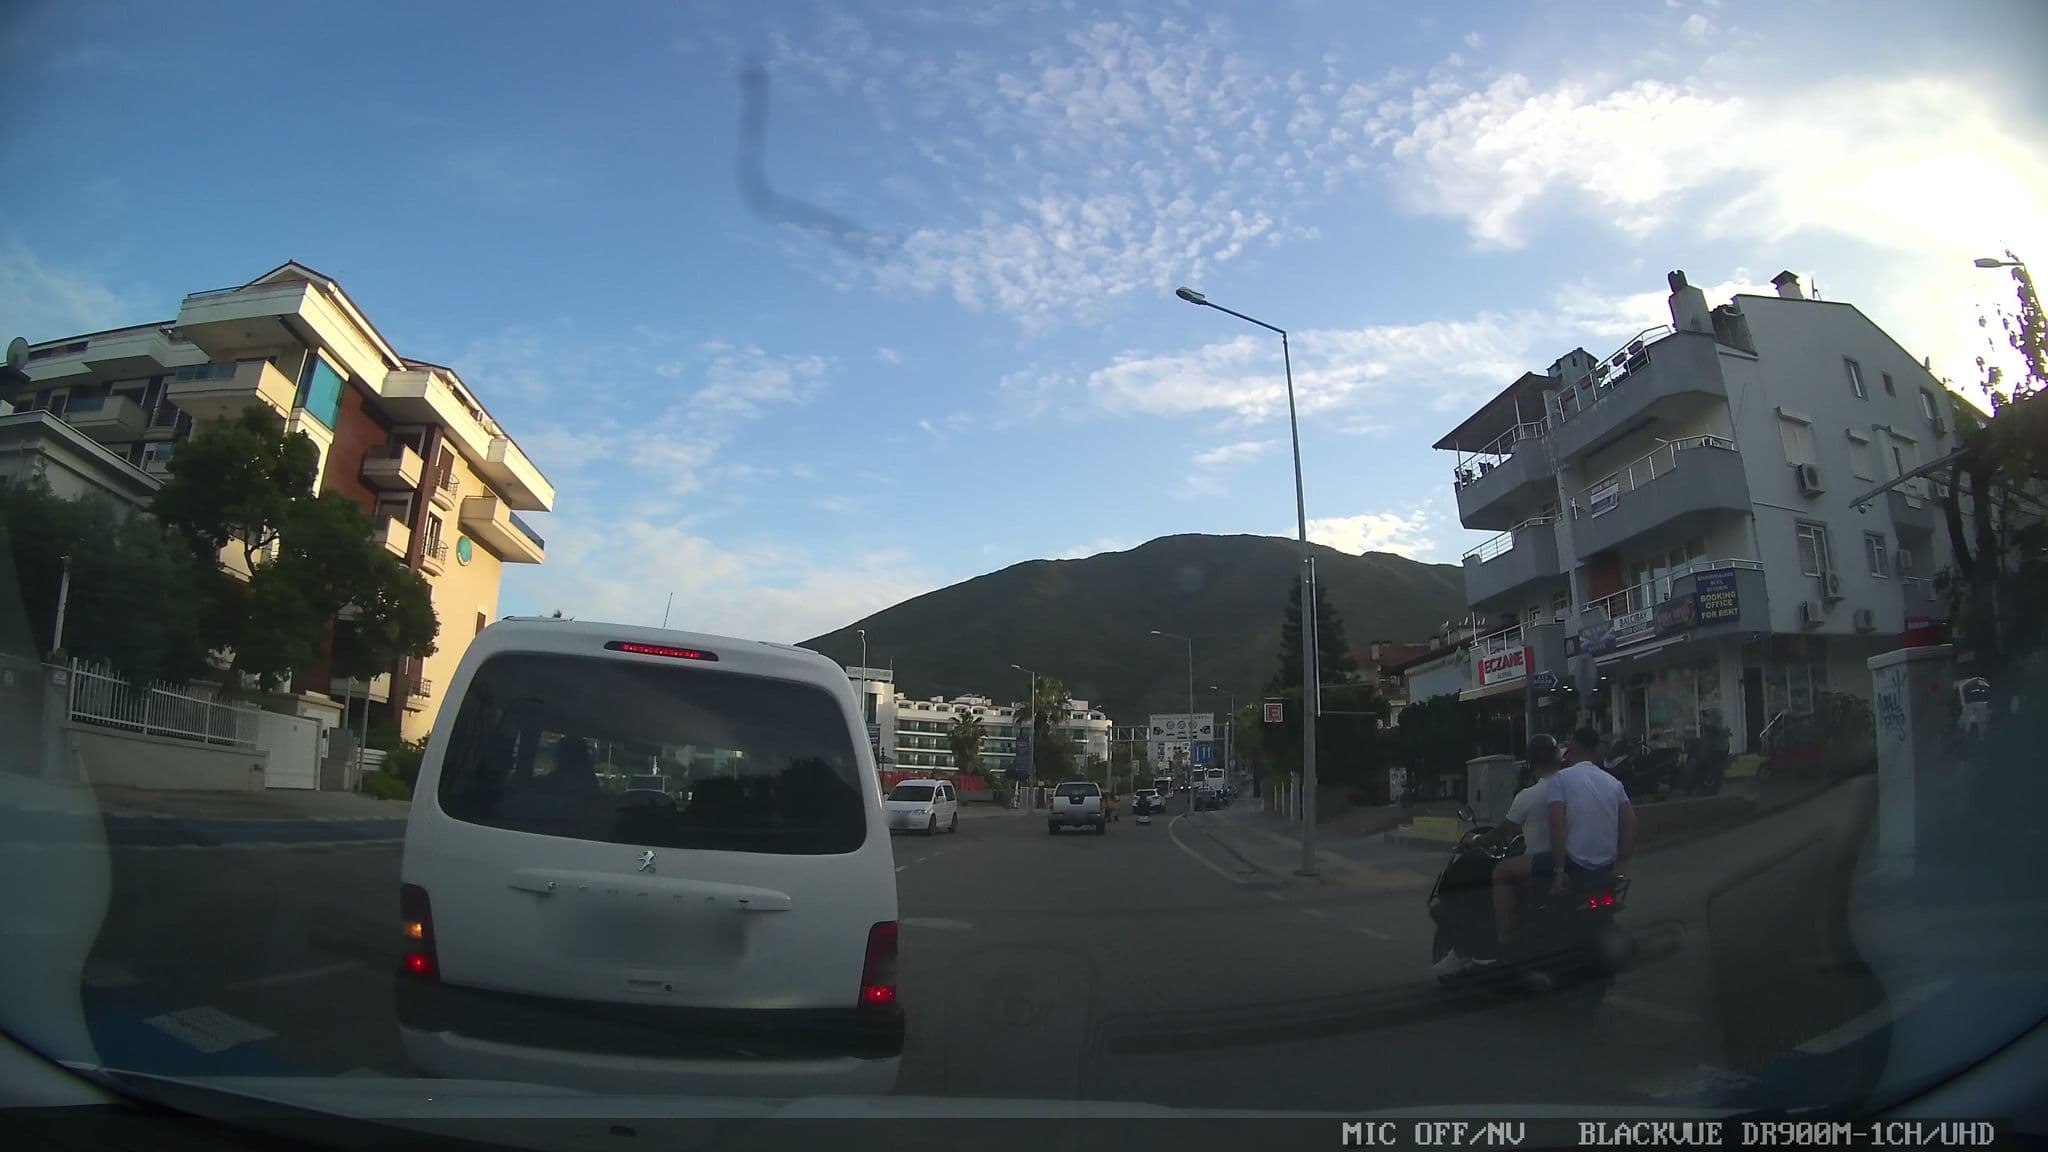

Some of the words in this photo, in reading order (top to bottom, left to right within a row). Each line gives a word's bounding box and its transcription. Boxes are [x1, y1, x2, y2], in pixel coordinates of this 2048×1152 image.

[1700, 591, 1736, 602] BOOKING
[1705, 599, 1734, 609] OFFICE
[1701, 610, 1718, 620] FOR
[1718, 607, 1739, 617] RENT
[1484, 650, 1524, 673] ECZANE
